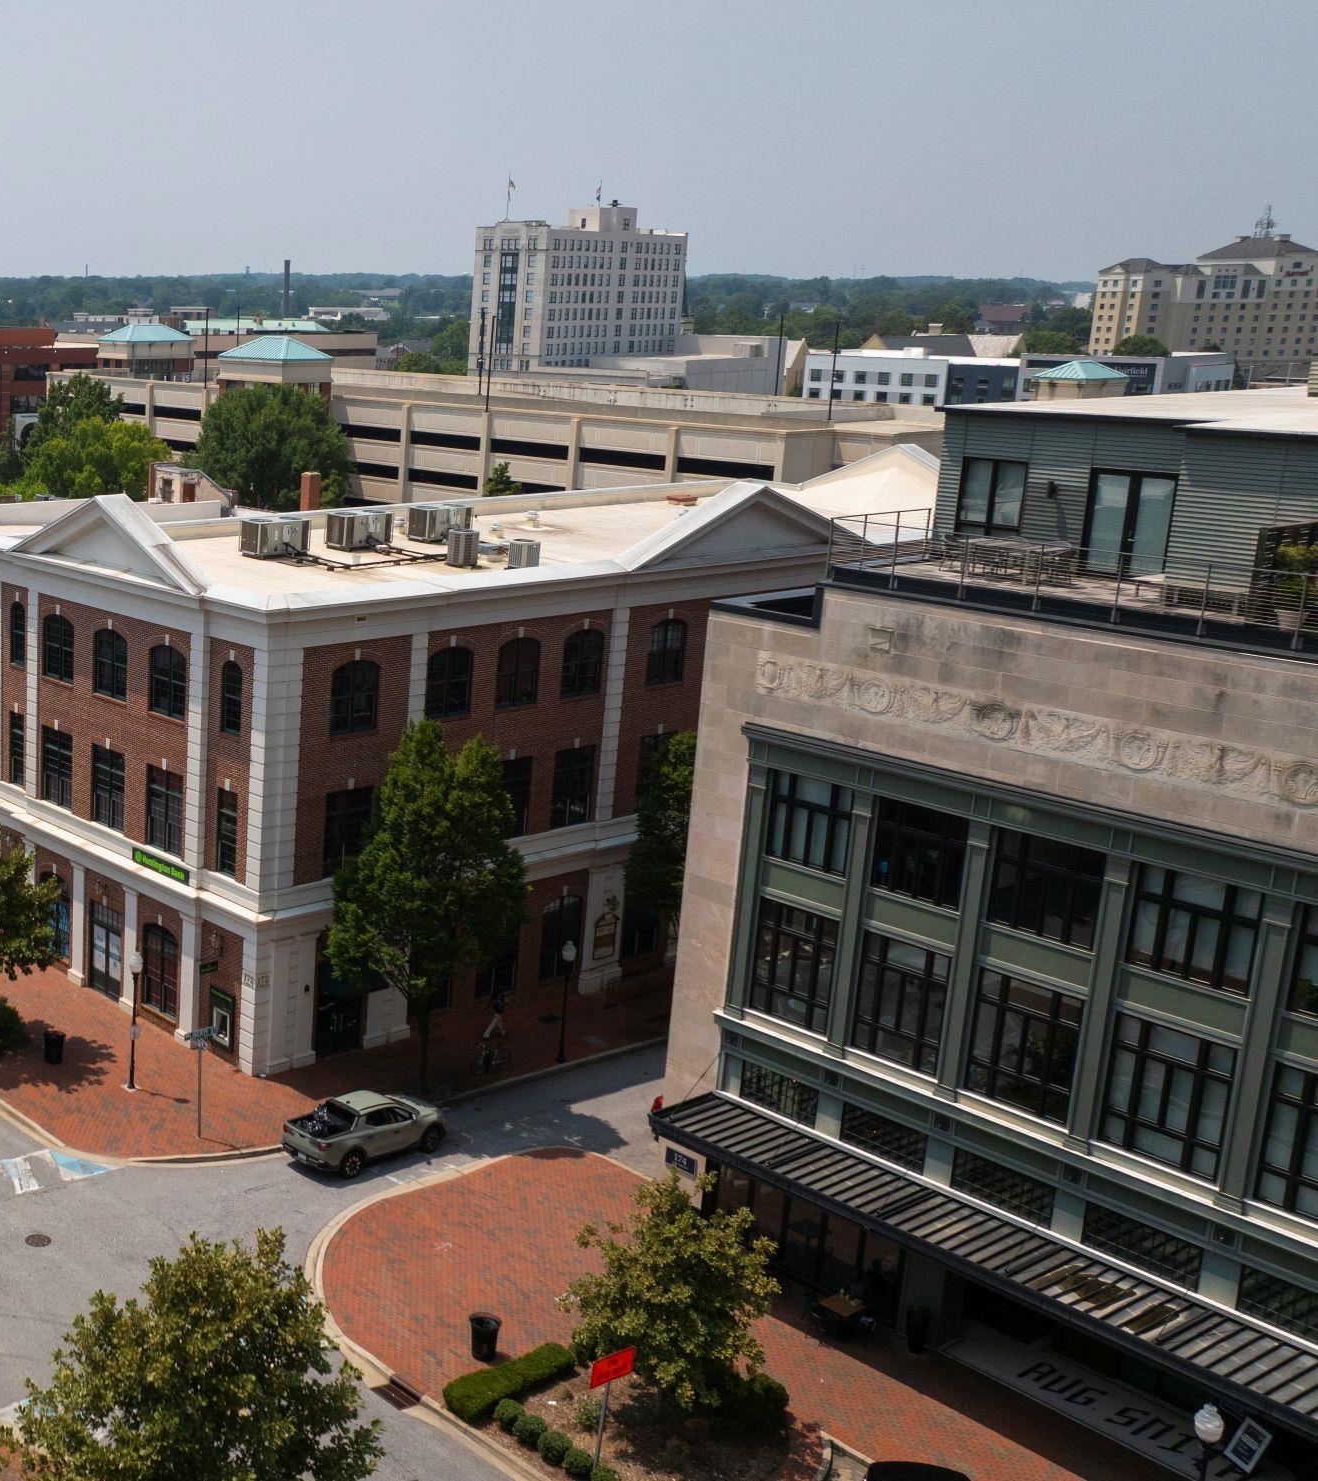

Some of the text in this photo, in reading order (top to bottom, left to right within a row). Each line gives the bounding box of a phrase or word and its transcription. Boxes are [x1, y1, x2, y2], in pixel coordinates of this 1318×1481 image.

[142, 854, 185, 880] Huntington Bank
[674, 1153, 687, 1165] 174
[1016, 1362, 1108, 1411] AUG.
